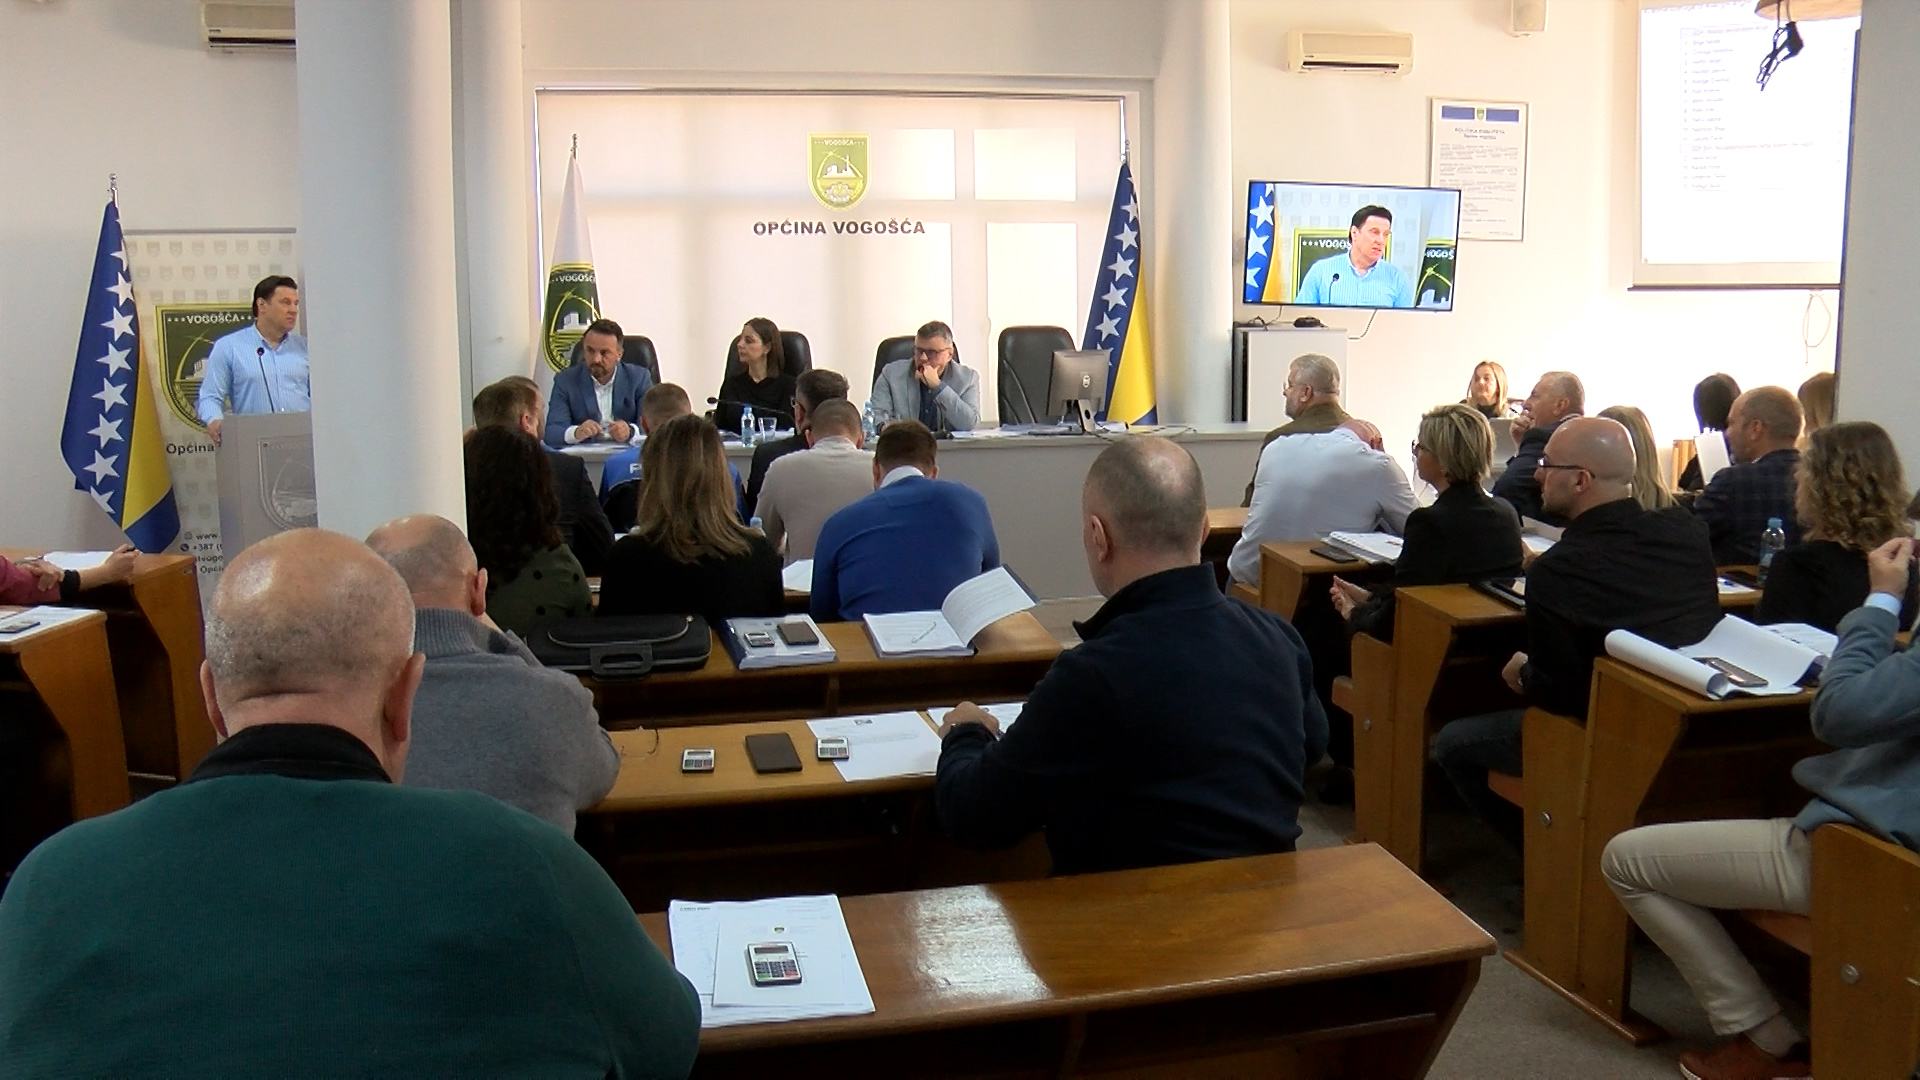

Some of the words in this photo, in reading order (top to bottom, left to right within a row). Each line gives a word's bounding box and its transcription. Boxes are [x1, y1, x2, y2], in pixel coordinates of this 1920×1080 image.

[753, 218, 826, 235] OPĆINA
[833, 218, 926, 235] VOGOŠĆA
[186, 312, 240, 324] VOGOŠĆA
[166, 442, 214, 455] Općina
